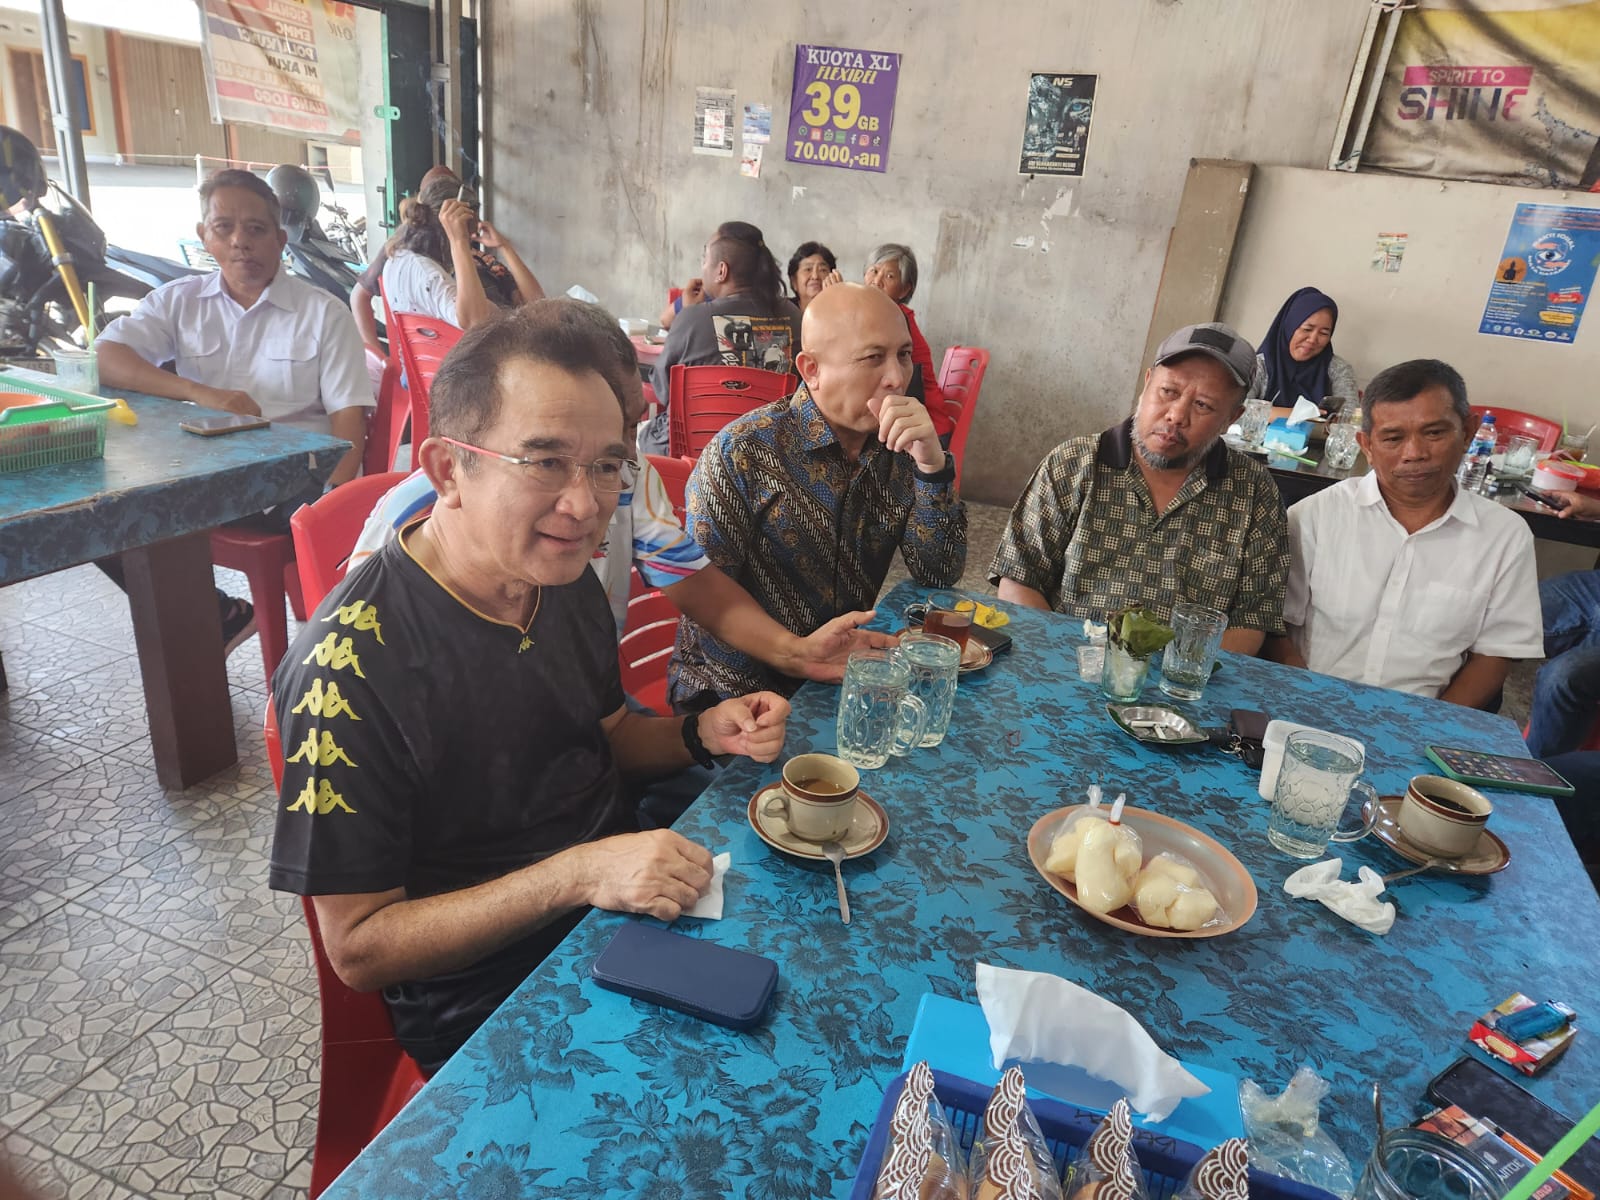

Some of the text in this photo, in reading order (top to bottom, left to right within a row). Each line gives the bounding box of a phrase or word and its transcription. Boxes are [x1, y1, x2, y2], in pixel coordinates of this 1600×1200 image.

[807, 48, 892, 71] KUOTA XL
[1429, 69, 1505, 83] SPIRIT TO
[802, 81, 861, 129] 39
[857, 115, 879, 131] GB
[1397, 87, 1528, 121] SHINE
[794, 140, 880, 167] 70.000,-an
